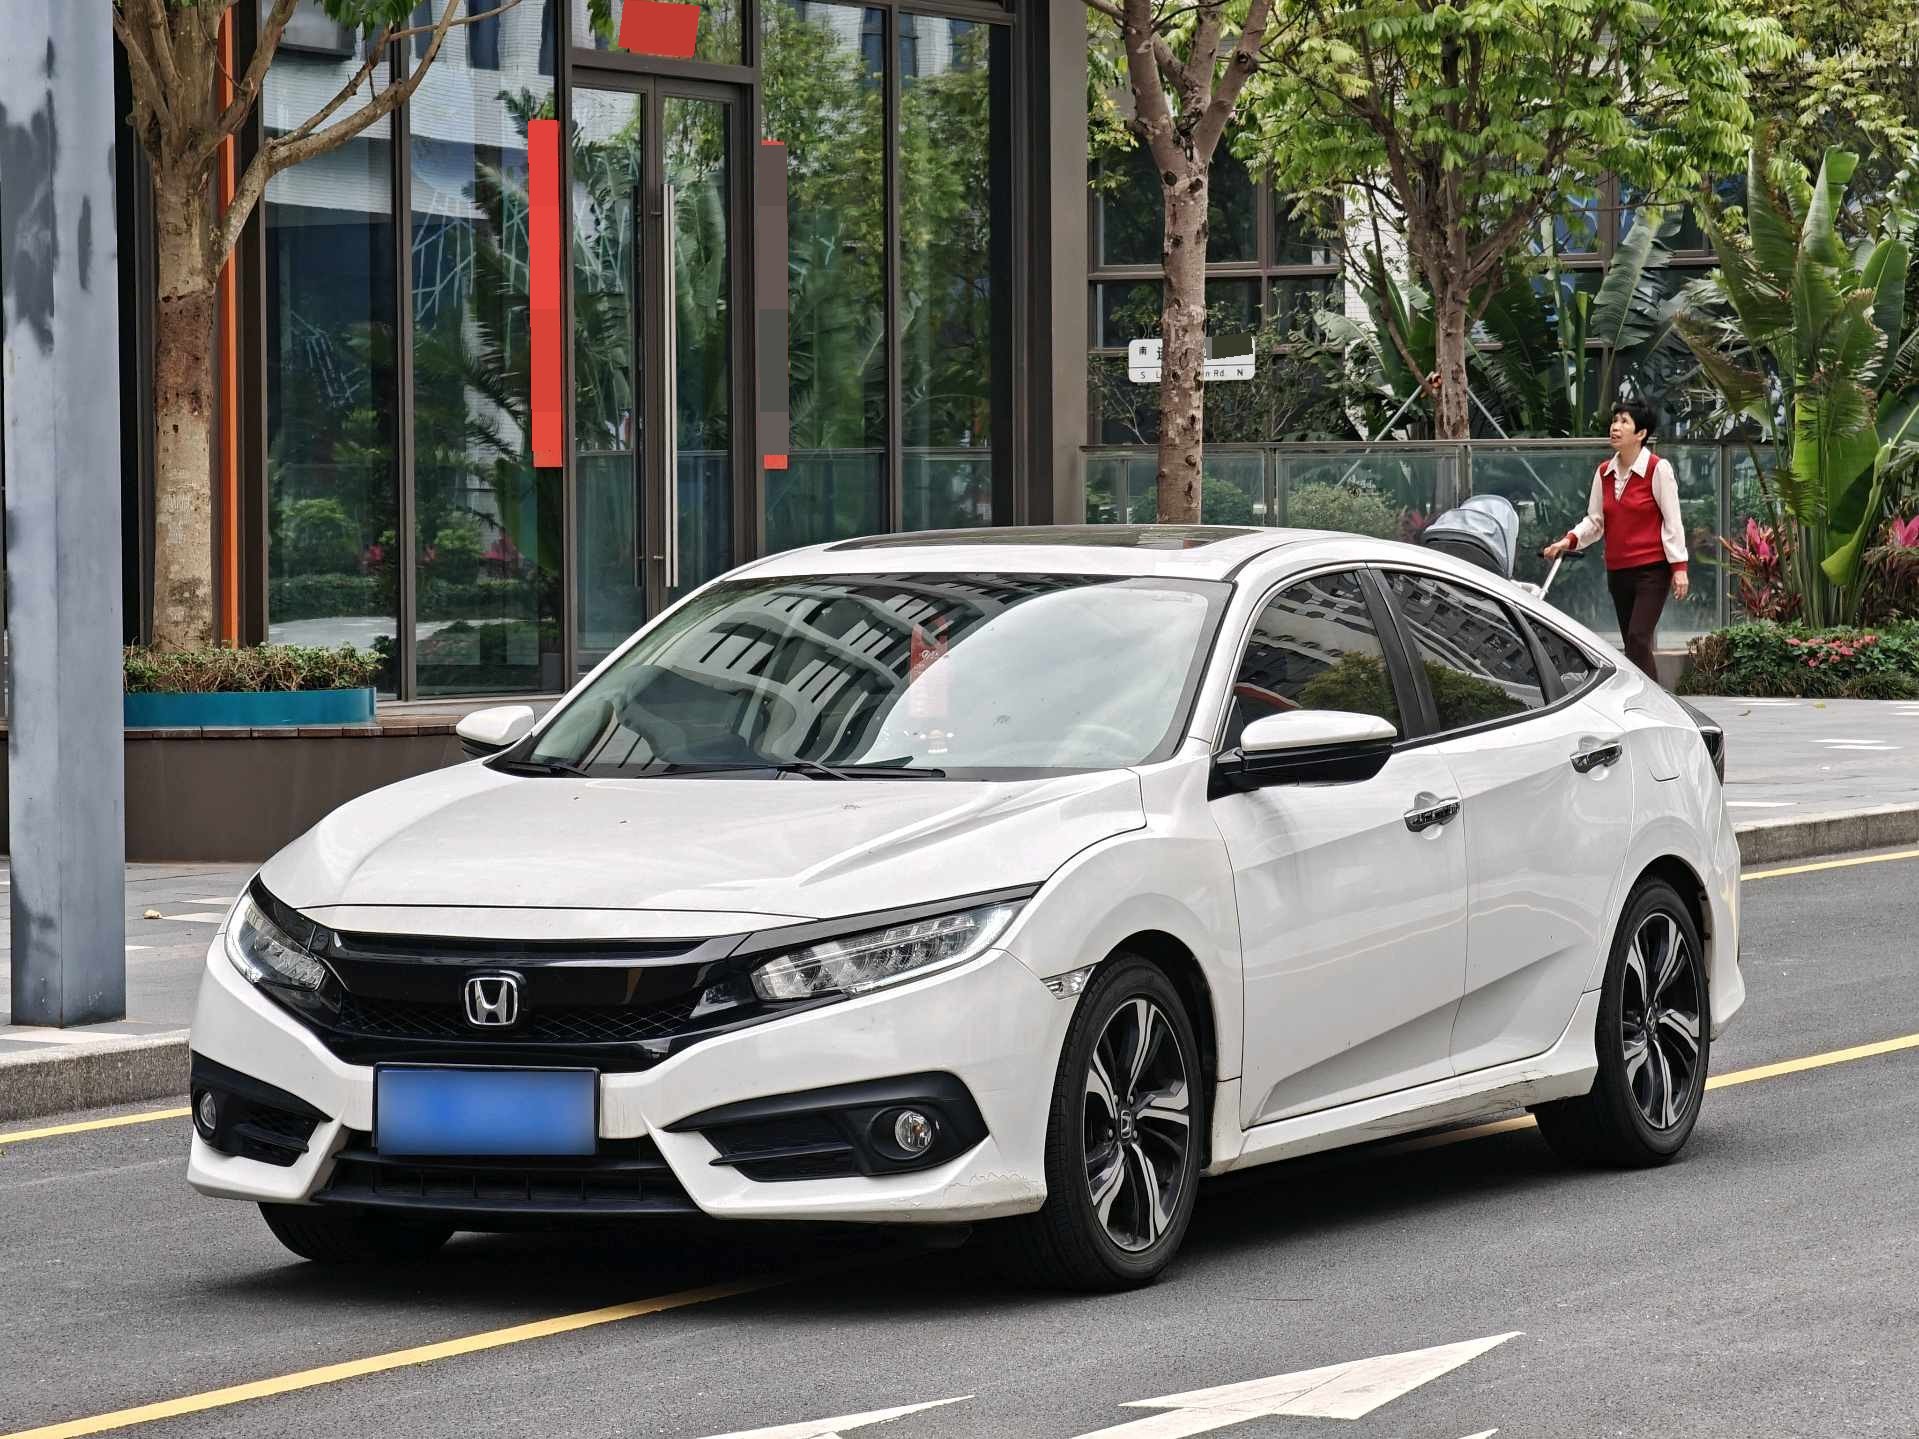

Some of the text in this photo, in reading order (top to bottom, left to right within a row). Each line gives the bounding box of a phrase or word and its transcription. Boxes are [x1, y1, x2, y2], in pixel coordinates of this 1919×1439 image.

[1140, 371, 1146, 379] S
[1213, 369, 1225, 377] Rd
[1237, 368, 1244, 377] N
